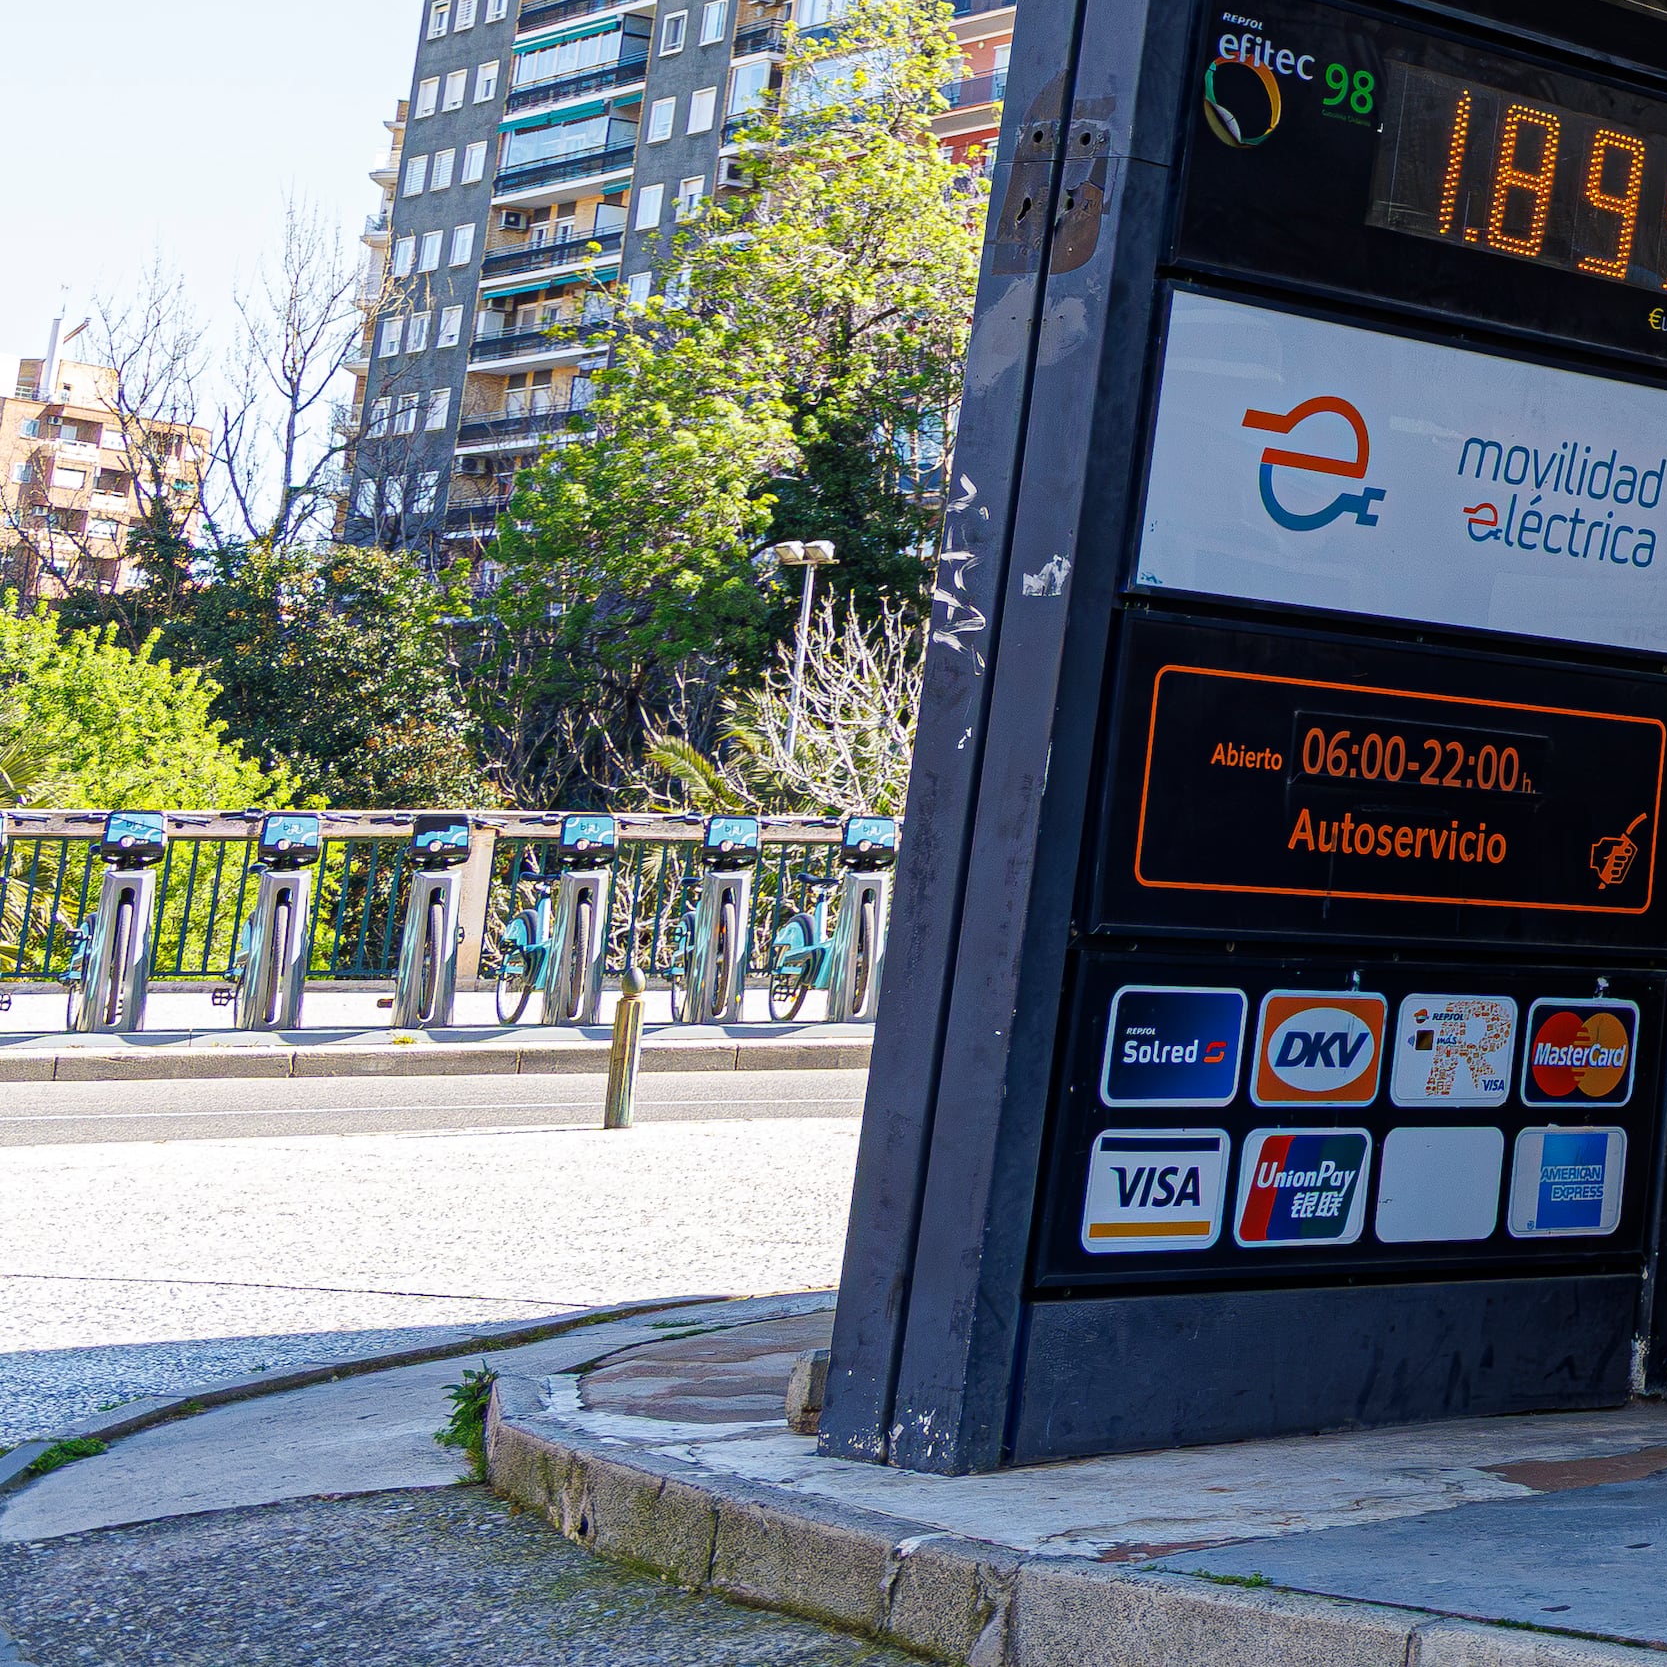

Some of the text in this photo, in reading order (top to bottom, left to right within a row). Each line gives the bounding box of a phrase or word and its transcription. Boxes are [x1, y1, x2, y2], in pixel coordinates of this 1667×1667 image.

[1222, 11, 1264, 31] REPSOL
[1218, 32, 1375, 114] efitec 98
[1457, 437, 1667, 509] movilidad
[1463, 494, 1657, 568] eléctrica
[1211, 727, 1537, 795] Abierto 06:00-22:00 h.
[1288, 808, 1507, 864] Autoservicio
[1432, 1011, 1464, 1023] REPSOL
[1126, 1027, 1156, 1035] REPSOL
[1436, 1034, 1457, 1046] más
[1122, 1038, 1199, 1064] Solred
[1273, 1031, 1370, 1069] DKV
[1533, 1042, 1627, 1069] MasterCard
[1481, 1078, 1505, 1091] VISA
[1109, 1165, 1202, 1208] VISA
[1256, 1160, 1357, 1196] UnionPay
[1541, 1166, 1602, 1182] AMERICAN
[1291, 1190, 1343, 1218] 银联
[1551, 1184, 1604, 1202] EXPRESS
